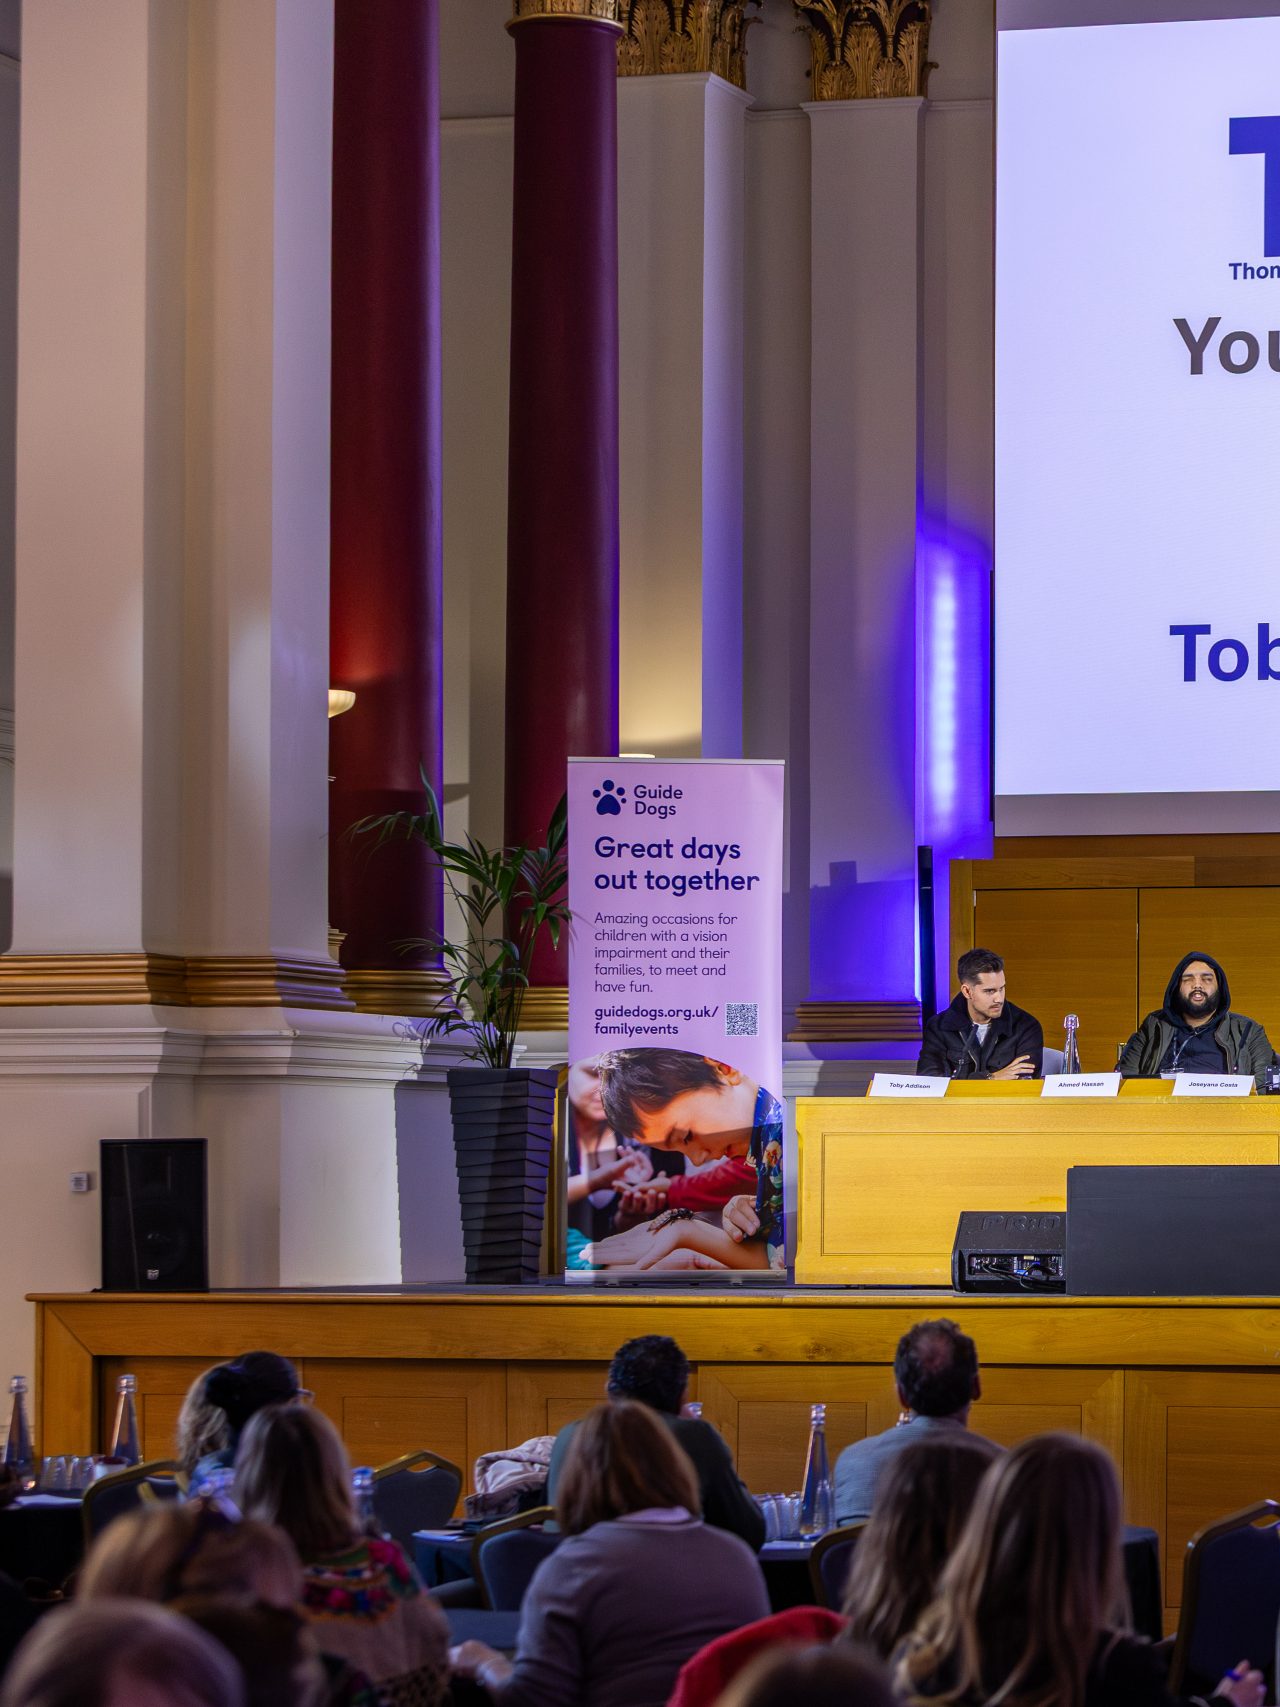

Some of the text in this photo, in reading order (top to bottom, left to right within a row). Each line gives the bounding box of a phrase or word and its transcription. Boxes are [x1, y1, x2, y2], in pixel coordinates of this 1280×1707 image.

[633, 784, 683, 799] Guide
[634, 800, 676, 819] Dogs
[594, 835, 740, 865] Great days
[594, 868, 759, 896] out together
[594, 911, 738, 928] Amazing occasions for
[594, 928, 727, 942] children with a vision
[594, 946, 730, 961] impairment and their
[594, 962, 726, 976] families, to meet and
[594, 980, 653, 993] have fun.
[594, 1022, 678, 1037] familyevents
